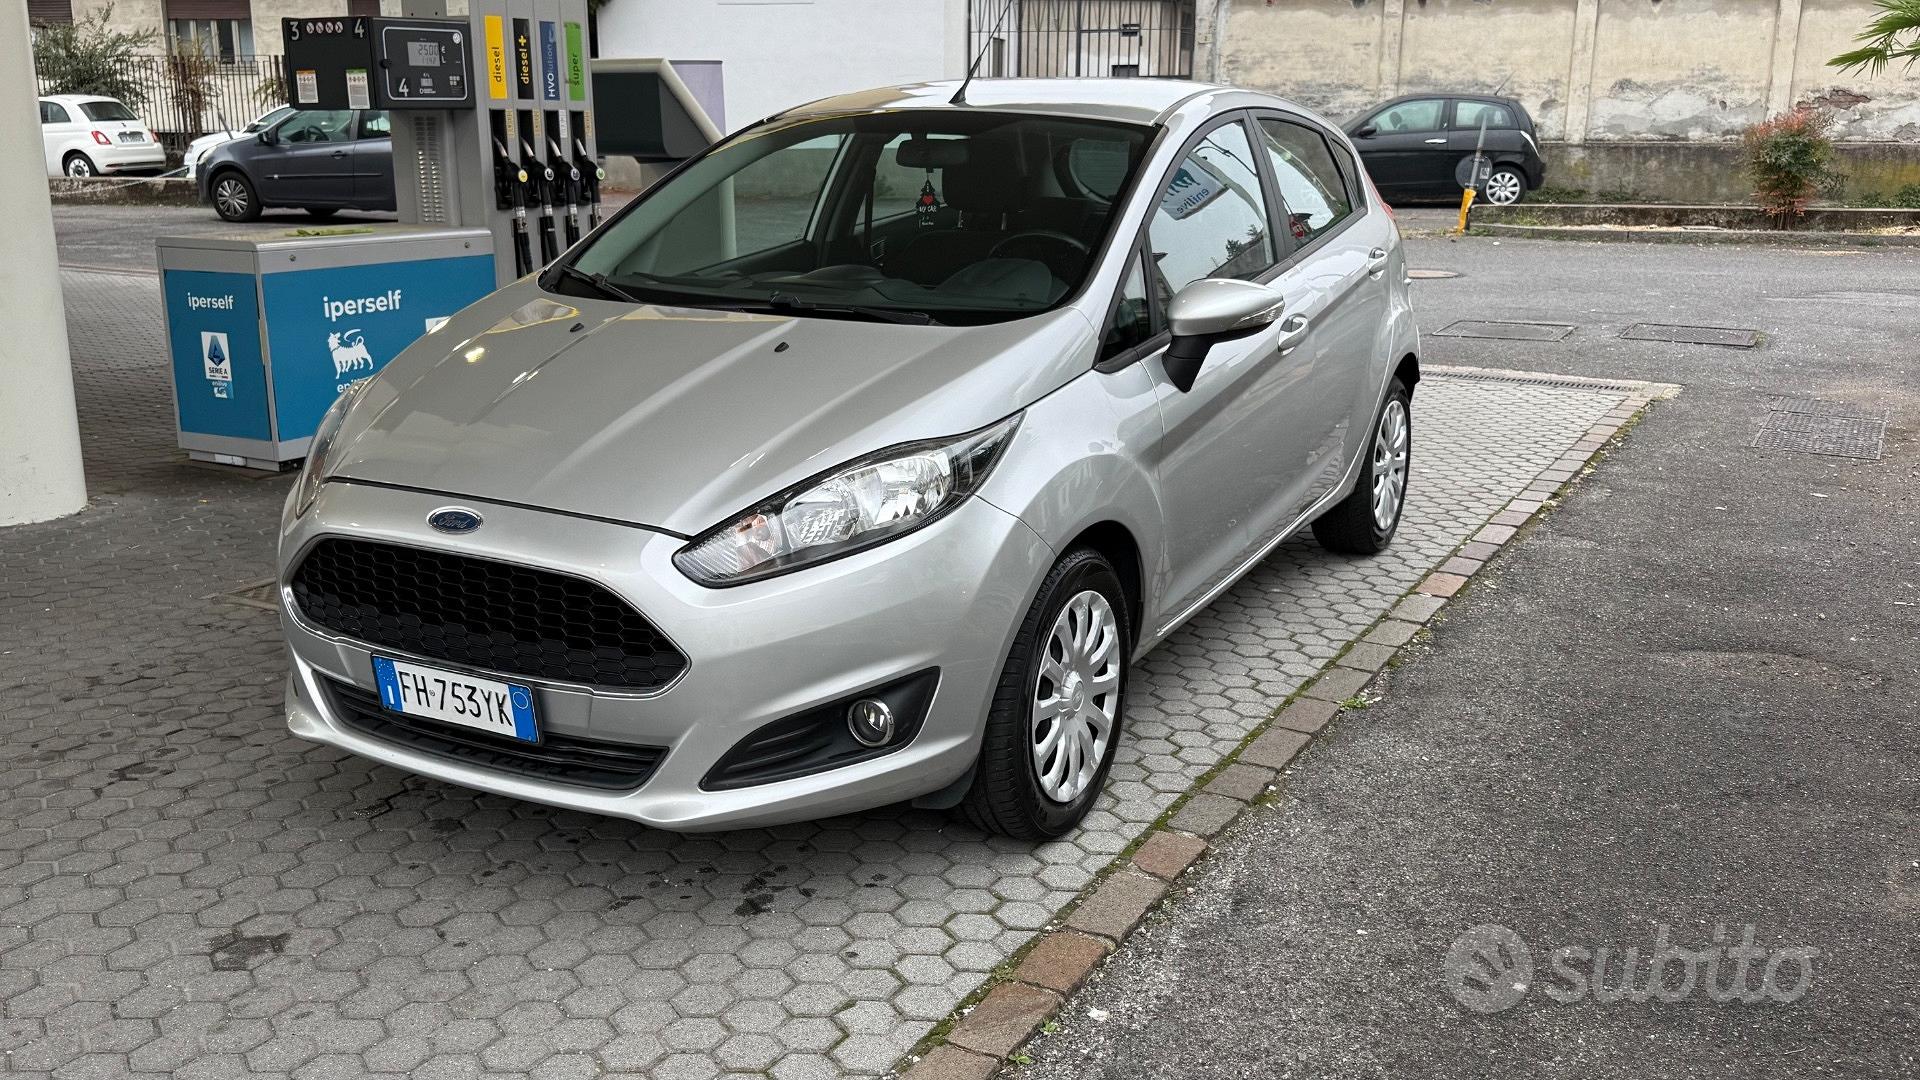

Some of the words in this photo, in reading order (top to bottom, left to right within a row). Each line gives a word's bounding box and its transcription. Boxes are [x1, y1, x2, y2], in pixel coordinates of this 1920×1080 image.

[289, 21, 300, 41] 3
[354, 18, 365, 38] 4
[491, 46, 502, 83] diesel
[546, 43, 556, 98] HVOlution
[572, 54, 581, 86] super
[398, 78, 409, 97] 4
[187, 292, 234, 311] iperself
[323, 289, 402, 322] iperself
[208, 367, 223, 375] SERIE
